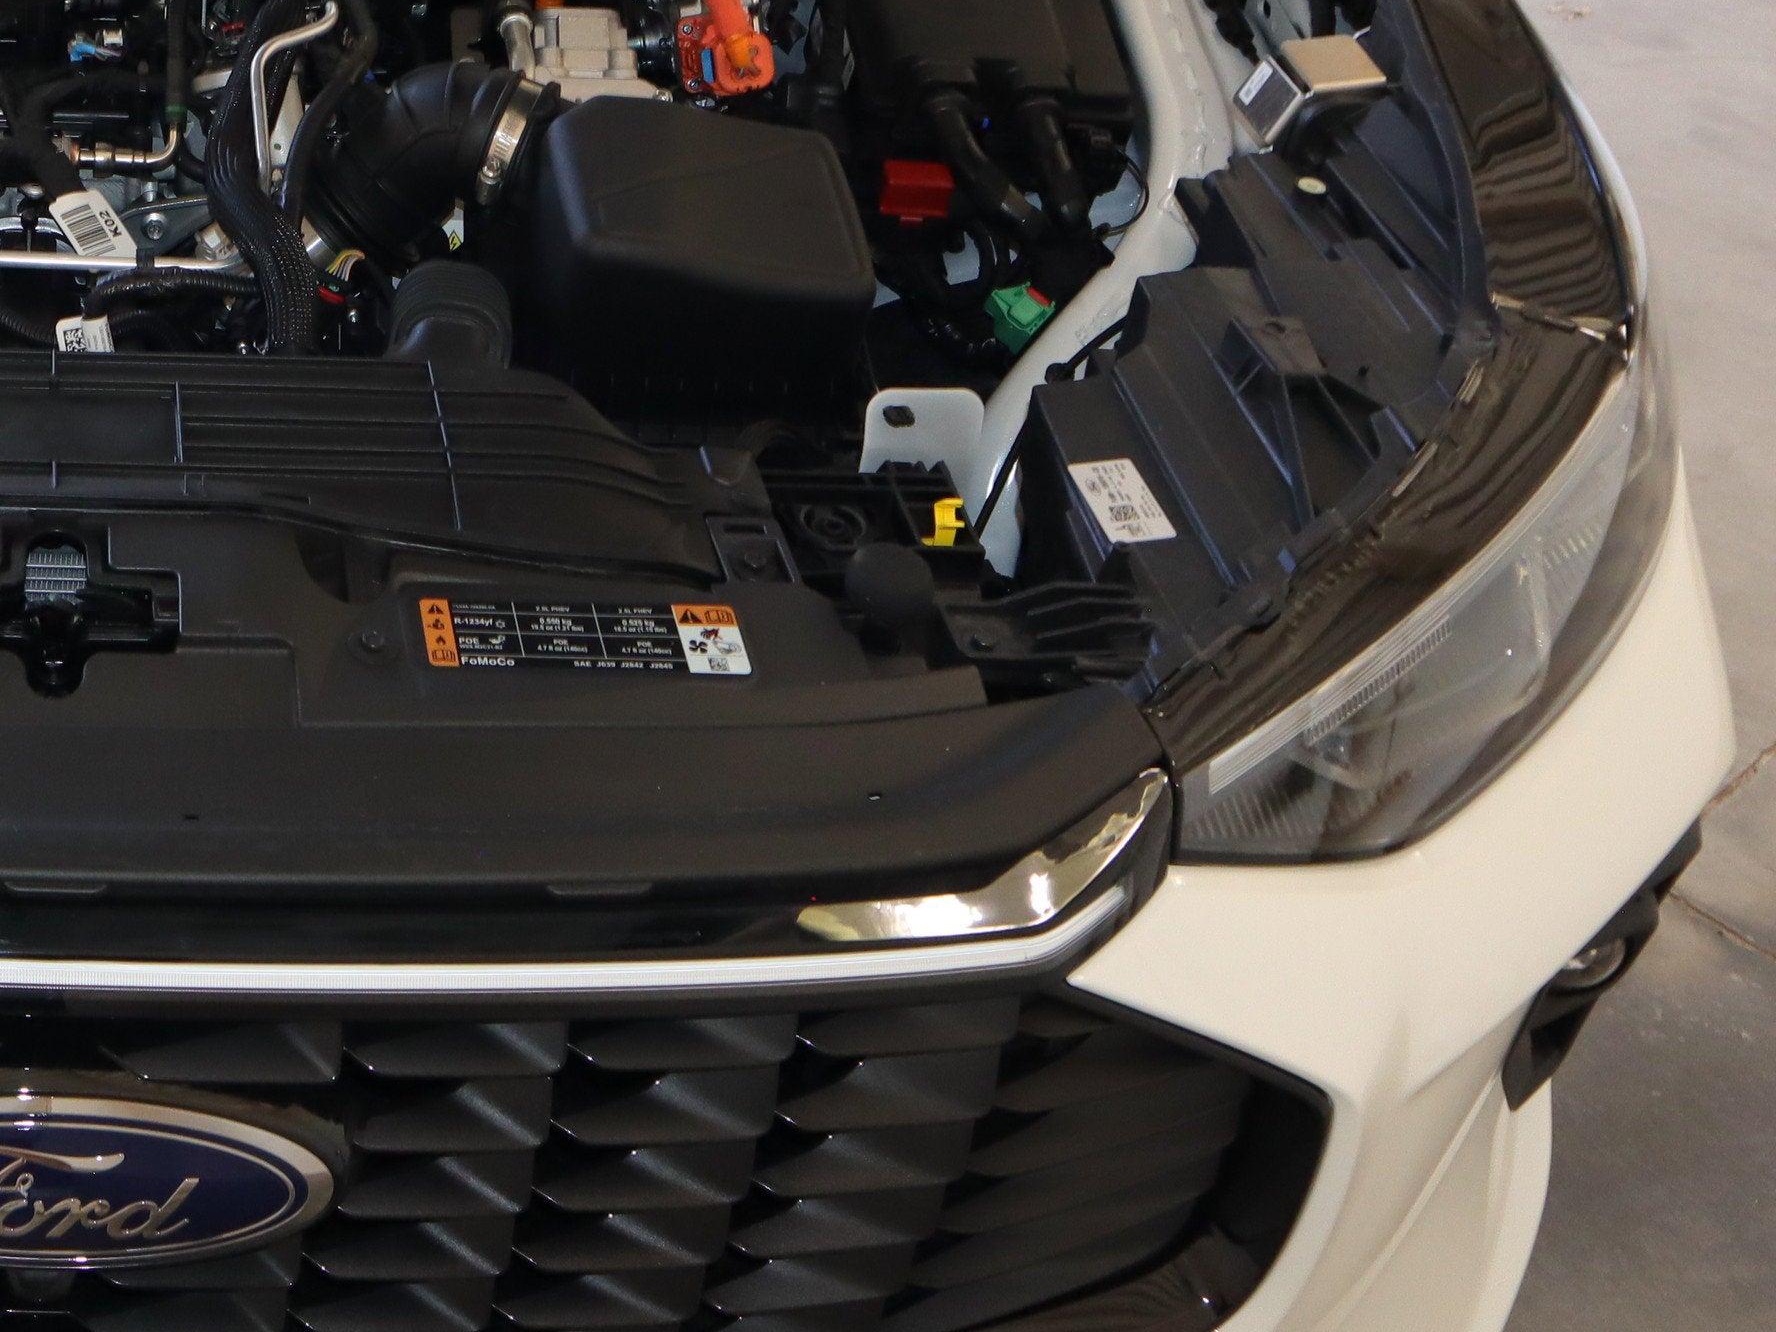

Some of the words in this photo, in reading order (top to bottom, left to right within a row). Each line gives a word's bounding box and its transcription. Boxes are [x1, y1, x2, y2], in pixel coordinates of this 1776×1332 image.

[99, 210, 122, 237] K02
[454, 617, 493, 627] R-1234yf
[561, 618, 572, 627] kg
[644, 619, 654, 628] kg
[458, 637, 479, 645] POE
[461, 656, 515, 666] FoMoCo
[573, 660, 591, 668] SAE
